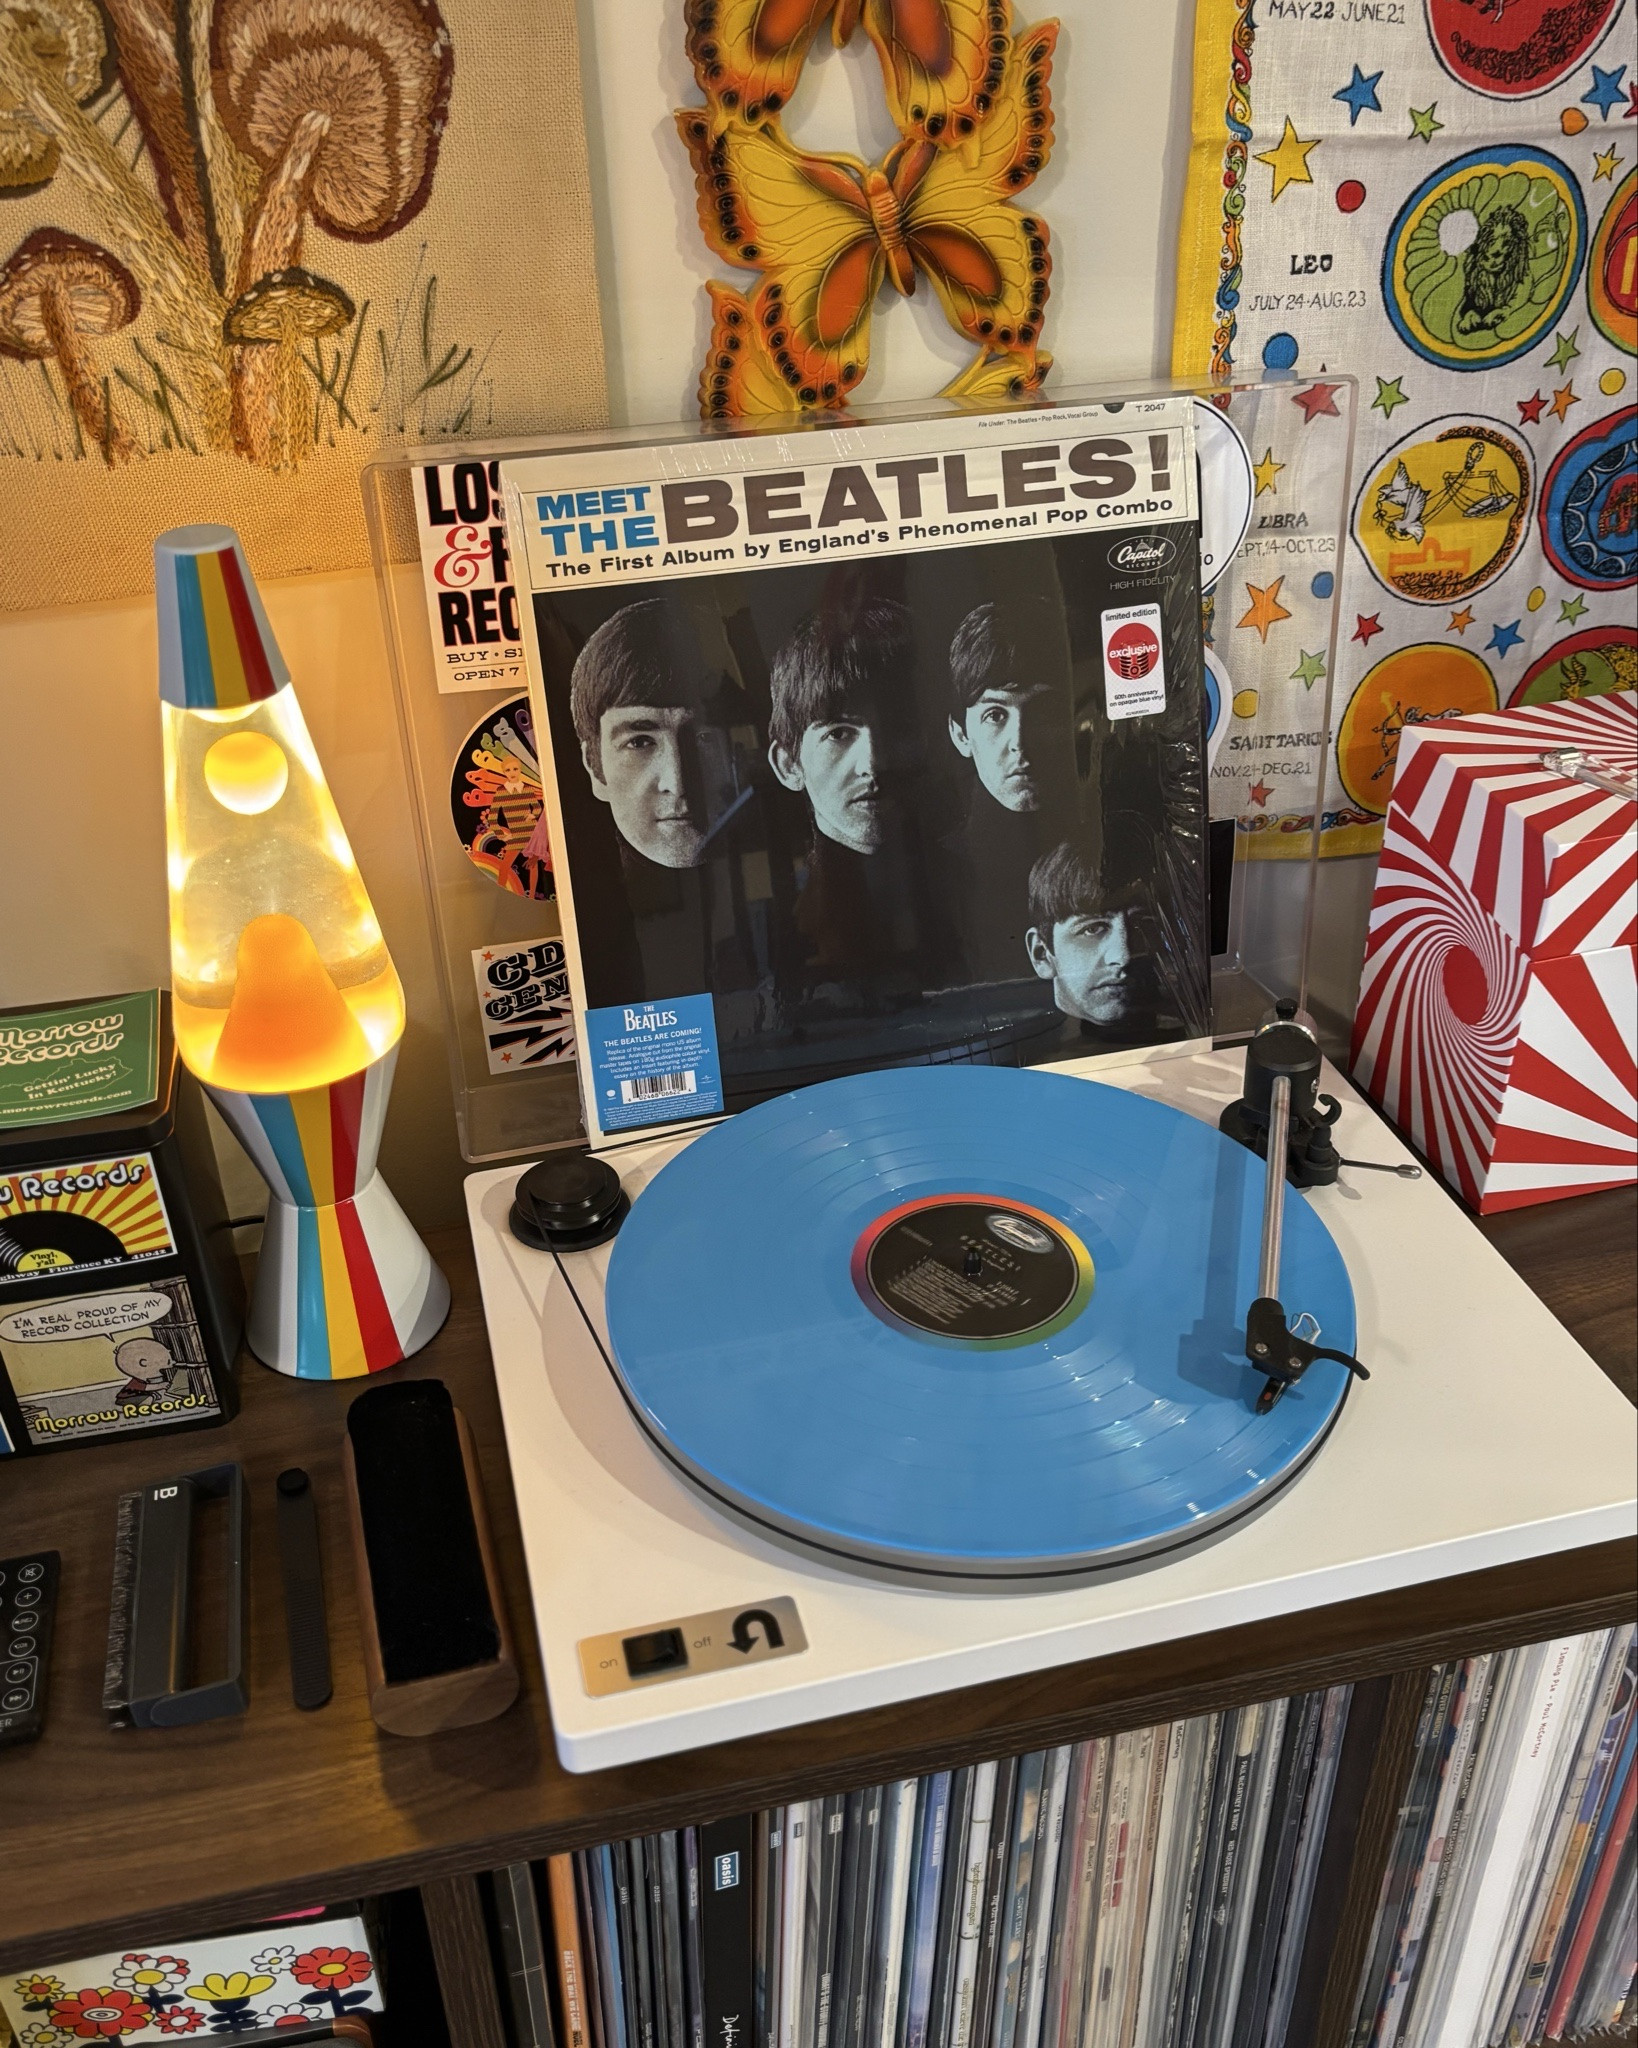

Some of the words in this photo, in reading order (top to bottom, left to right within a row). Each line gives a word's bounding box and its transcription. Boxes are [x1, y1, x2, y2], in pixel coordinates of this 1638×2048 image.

[1289, 253, 1334, 276] LEO
[1249, 294, 1285, 311] JULY
[1017, 416, 1038, 424] Beatles
[1082, 410, 1099, 418] Group
[1135, 405, 1142, 413] T
[1143, 403, 1166, 412] 2047
[661, 433, 1171, 544] BEATLES!
[536, 486, 651, 522] MEET
[540, 515, 660, 557] THE
[545, 561, 591, 578] The
[600, 553, 654, 573] First
[662, 547, 735, 566] Album
[744, 541, 771, 559] by
[779, 527, 890, 555] England's
[898, 511, 1038, 541] Phenomenal
[1046, 506, 1088, 526] Pop
[1096, 498, 1173, 518] Combo
[434, 525, 492, 588] &
[1117, 542, 1167, 564] Capitol
[1126, 560, 1161, 569] RECORDS
[1109, 580, 1135, 590] HIGH
[1136, 575, 1177, 588] FIDELITY
[1105, 611, 1131, 622] limited
[1132, 608, 1158, 619] edition
[446, 651, 489, 664] BUY
[1109, 643, 1158, 658] exclusive
[454, 669, 504, 681] OPEN
[509, 667, 519, 676] 7
[1118, 699, 1138, 707] opaque
[1127, 689, 1158, 699] anniversary
[623, 1009, 678, 1032] BEATLES
[603, 1039, 619, 1048] THE
[620, 1035, 653, 1045] BEATLES
[654, 1031, 669, 1041] ARE
[670, 1027, 702, 1038] COMING!
[23, 1075, 71, 1093] Gettin'
[74, 1063, 117, 1080] Lucky
[28, 1091, 44, 1100] In
[46, 1070, 118, 1095] Kentucky!
[19, 1162, 145, 1202] Records
[36, 1258, 56, 1268] y'all
[48, 1260, 102, 1274] Florence
[103, 1255, 123, 1265] KY
[131, 1249, 167, 1261] 41042
[12, 1317, 34, 1329] I'M
[39, 1314, 72, 1325] REAL
[77, 1306, 117, 1319] PROUD
[120, 1303, 139, 1312] OF
[144, 1298, 162, 1310] MY
[21, 1324, 70, 1339] RECORD
[74, 1310, 150, 1332] COLLECTION
[34, 1409, 119, 1434] Morrow
[122, 1394, 207, 1418] Records
[693, 1636, 712, 1650] off
[599, 1657, 618, 1670] on
[1541, 1702, 1553, 1720] Paul
[1172, 1724, 1184, 1759] McCartney
[1530, 1722, 1547, 1758] McCartney
[721, 1857, 735, 1886] oasis
